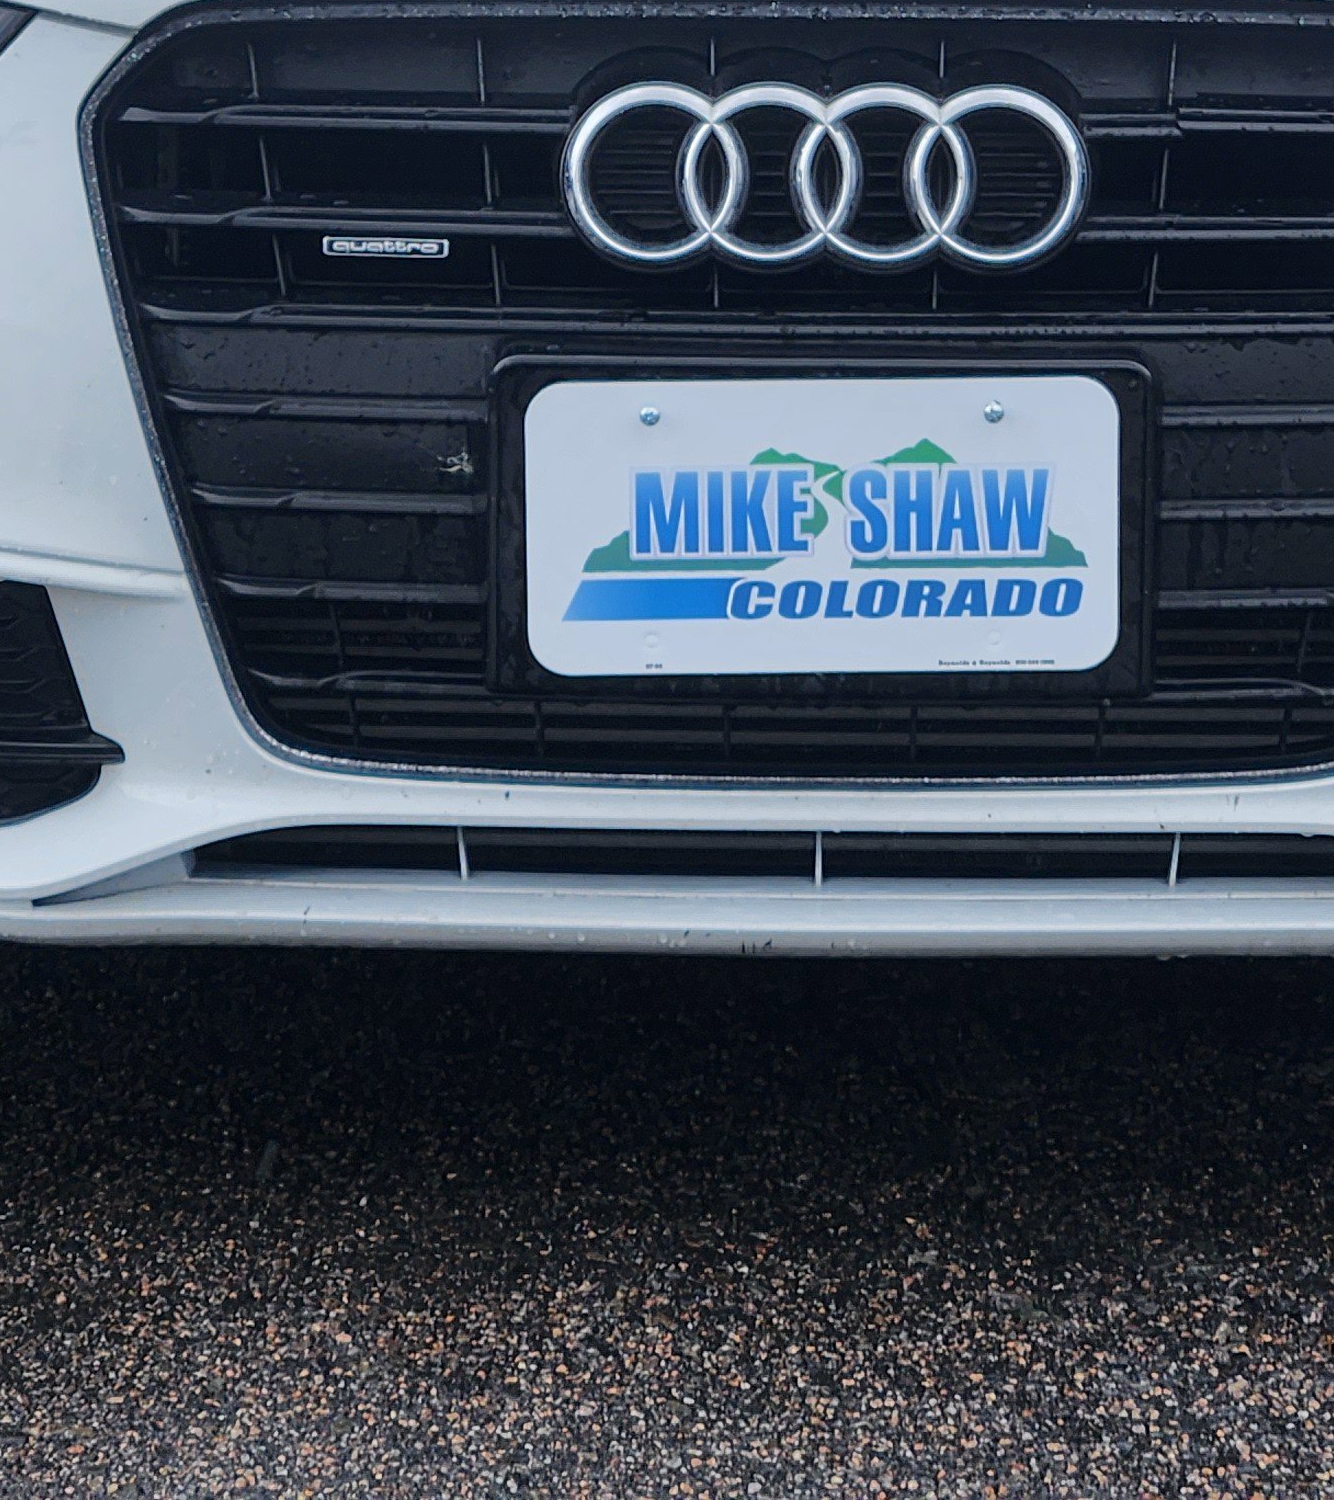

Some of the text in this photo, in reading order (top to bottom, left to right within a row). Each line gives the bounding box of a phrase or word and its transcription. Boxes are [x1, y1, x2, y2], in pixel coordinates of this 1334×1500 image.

[332, 240, 440, 254] quattro
[633, 468, 1050, 554] MIKE SHAW
[730, 577, 1085, 620] COLORADO
